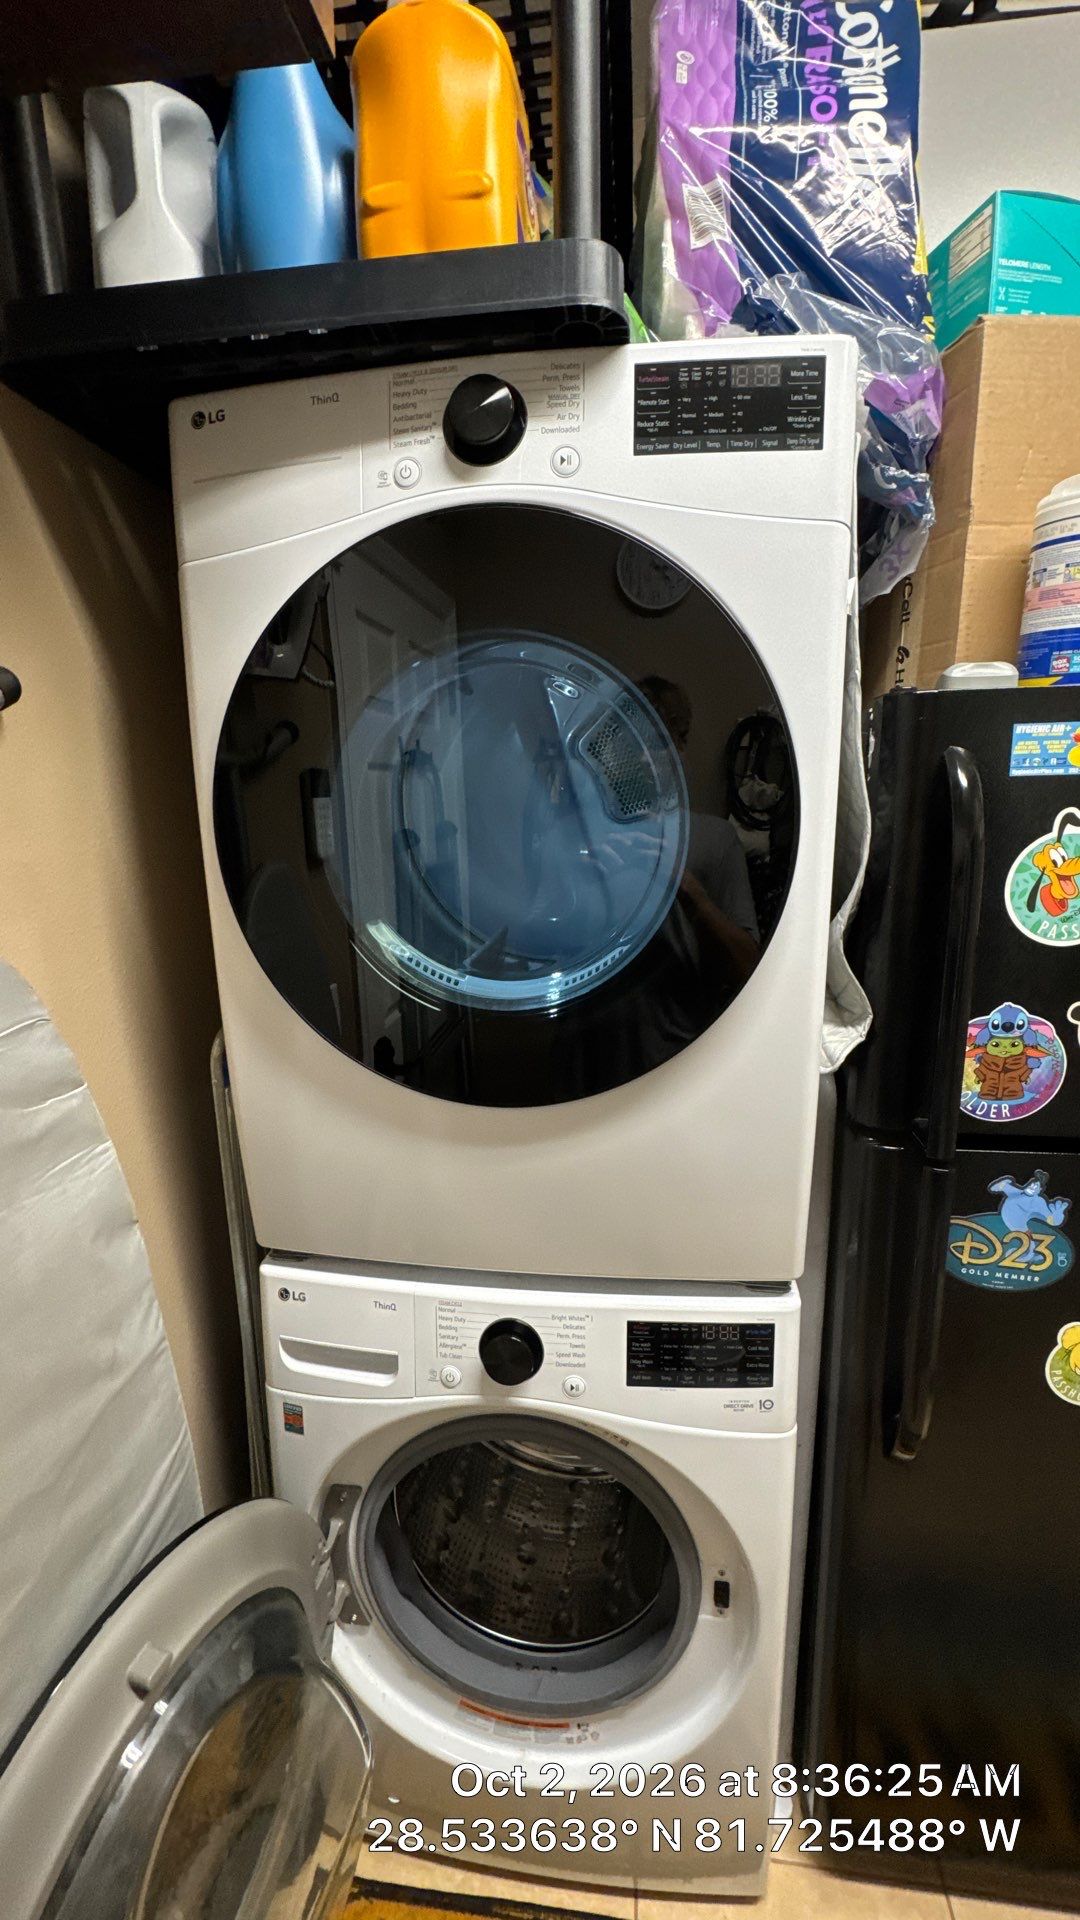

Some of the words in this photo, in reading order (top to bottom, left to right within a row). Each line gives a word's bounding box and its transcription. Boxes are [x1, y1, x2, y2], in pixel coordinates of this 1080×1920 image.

[393, 390, 411, 398] Heavy
[412, 388, 428, 397] Duty
[559, 384, 580, 392] Towels
[310, 392, 340, 406] ThinQ
[393, 401, 417, 411] Bedding
[547, 401, 566, 410] Speed
[568, 400, 580, 409] Dry
[208, 409, 226, 425] LG
[393, 411, 432, 423] Antibacterial
[568, 413, 580, 422] Dry
[540, 425, 581, 434] Downloaded
[393, 438, 412, 449] Steam
[949, 1219, 1056, 1272] D23
[961, 1267, 989, 1277] GOLD
[995, 1271, 1041, 1283] MEMBER
[292, 1291, 307, 1302] LG
[373, 1301, 397, 1311] ThinQ
[454, 1316, 466, 1324] Duty
[552, 1314, 567, 1322] Bright
[438, 1324, 458, 1332] Bedding
